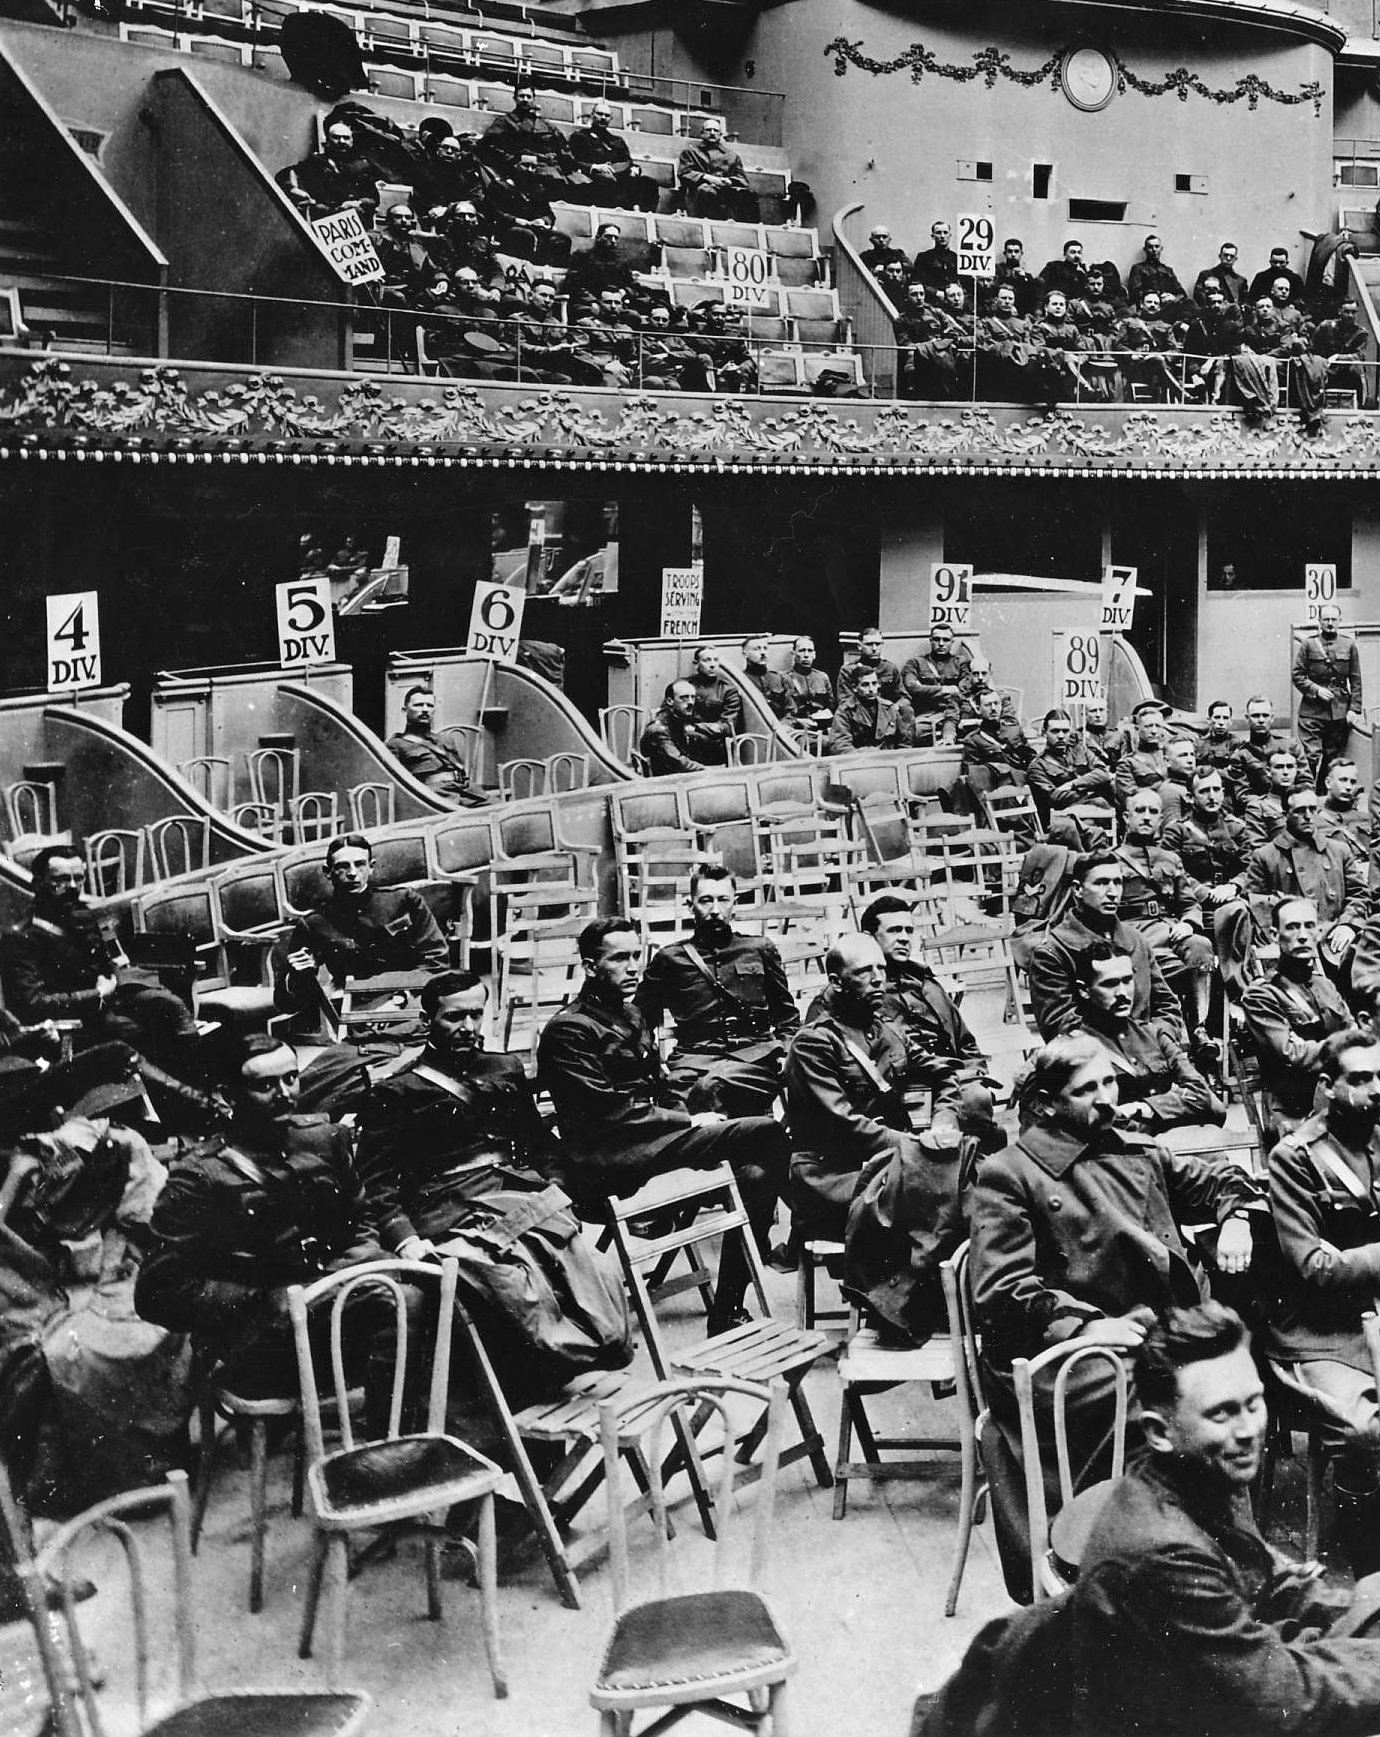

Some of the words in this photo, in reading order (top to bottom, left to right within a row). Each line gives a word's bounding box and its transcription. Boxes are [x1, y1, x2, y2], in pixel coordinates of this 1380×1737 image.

[318, 215, 362, 245] PARIS
[959, 218, 994, 251] 29
[331, 239, 370, 263] COM-
[959, 254, 992, 271] DIV.
[733, 252, 765, 284] 80
[667, 574, 700, 589] TROOPS
[934, 568, 970, 602] 91
[1112, 570, 1133, 604] 7
[1308, 569, 1335, 600] 30
[287, 586, 325, 632] 5
[481, 589, 515, 630] 6
[665, 591, 700, 606] SERVING
[54, 600, 89, 651] 4
[663, 620, 698, 635] FRENCH
[931, 607, 969, 624] DIV.
[283, 634, 329, 662] DIV.
[470, 632, 516, 656] DIV.
[1067, 636, 1100, 675] 89
[52, 654, 97, 684] DIV.
